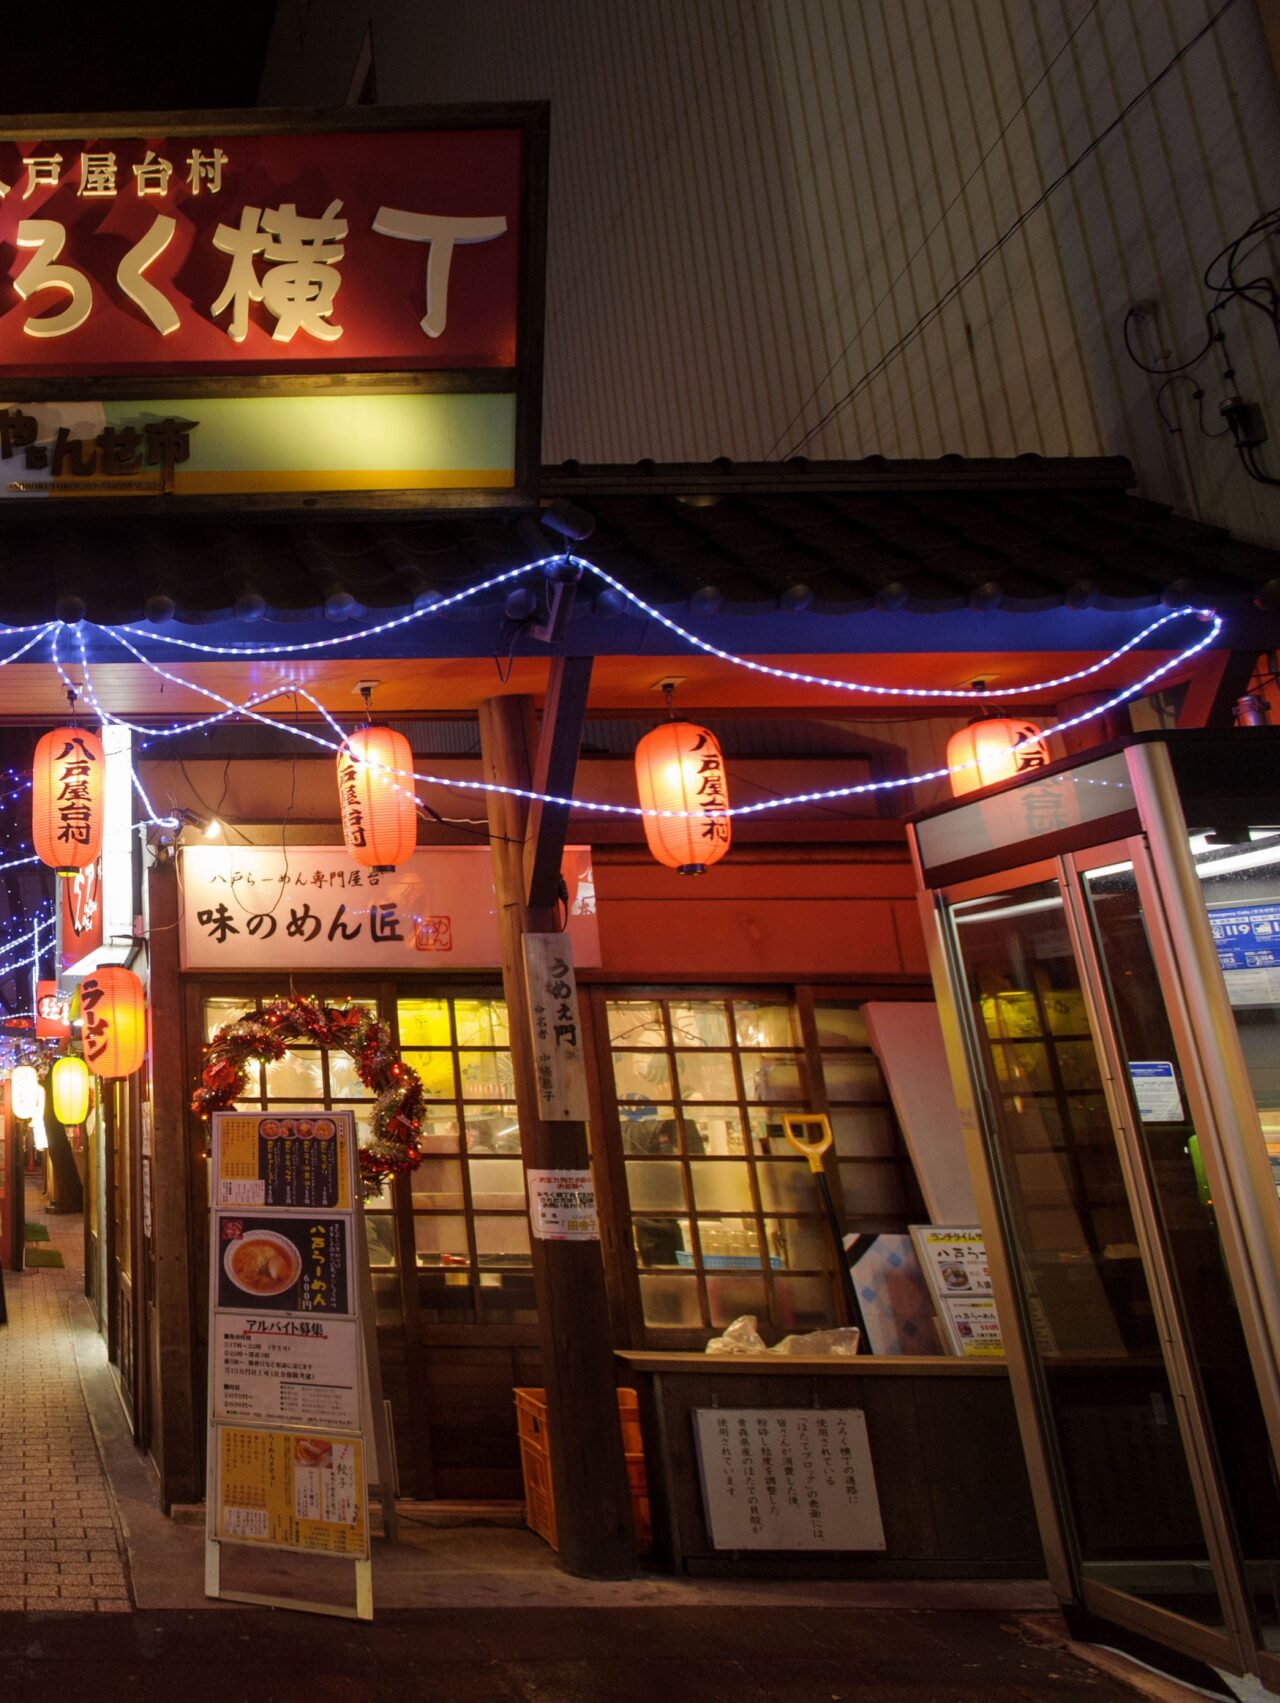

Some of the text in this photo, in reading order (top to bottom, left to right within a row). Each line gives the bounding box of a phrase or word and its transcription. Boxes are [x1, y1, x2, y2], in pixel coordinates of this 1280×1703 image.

[54, 737, 96, 845] 八戸屋台村
[689, 729, 729, 844] 八戸屋台村
[210, 869, 381, 889] 八戸らーめん専門屋台
[197, 902, 405, 944] 味のめん匠
[1225, 924, 1250, 936] 119
[81, 979, 109, 1061] ラーメン
[302, 1273, 313, 1311] 600円
[308, 1224, 328, 1307] 八戸らーめん
[246, 1320, 324, 1337] アルバイト募集
[717, 1418, 737, 1496] 使用されています
[816, 1418, 836, 1486] 使用されている
[836, 1418, 858, 1504] みろく横丁の通路に
